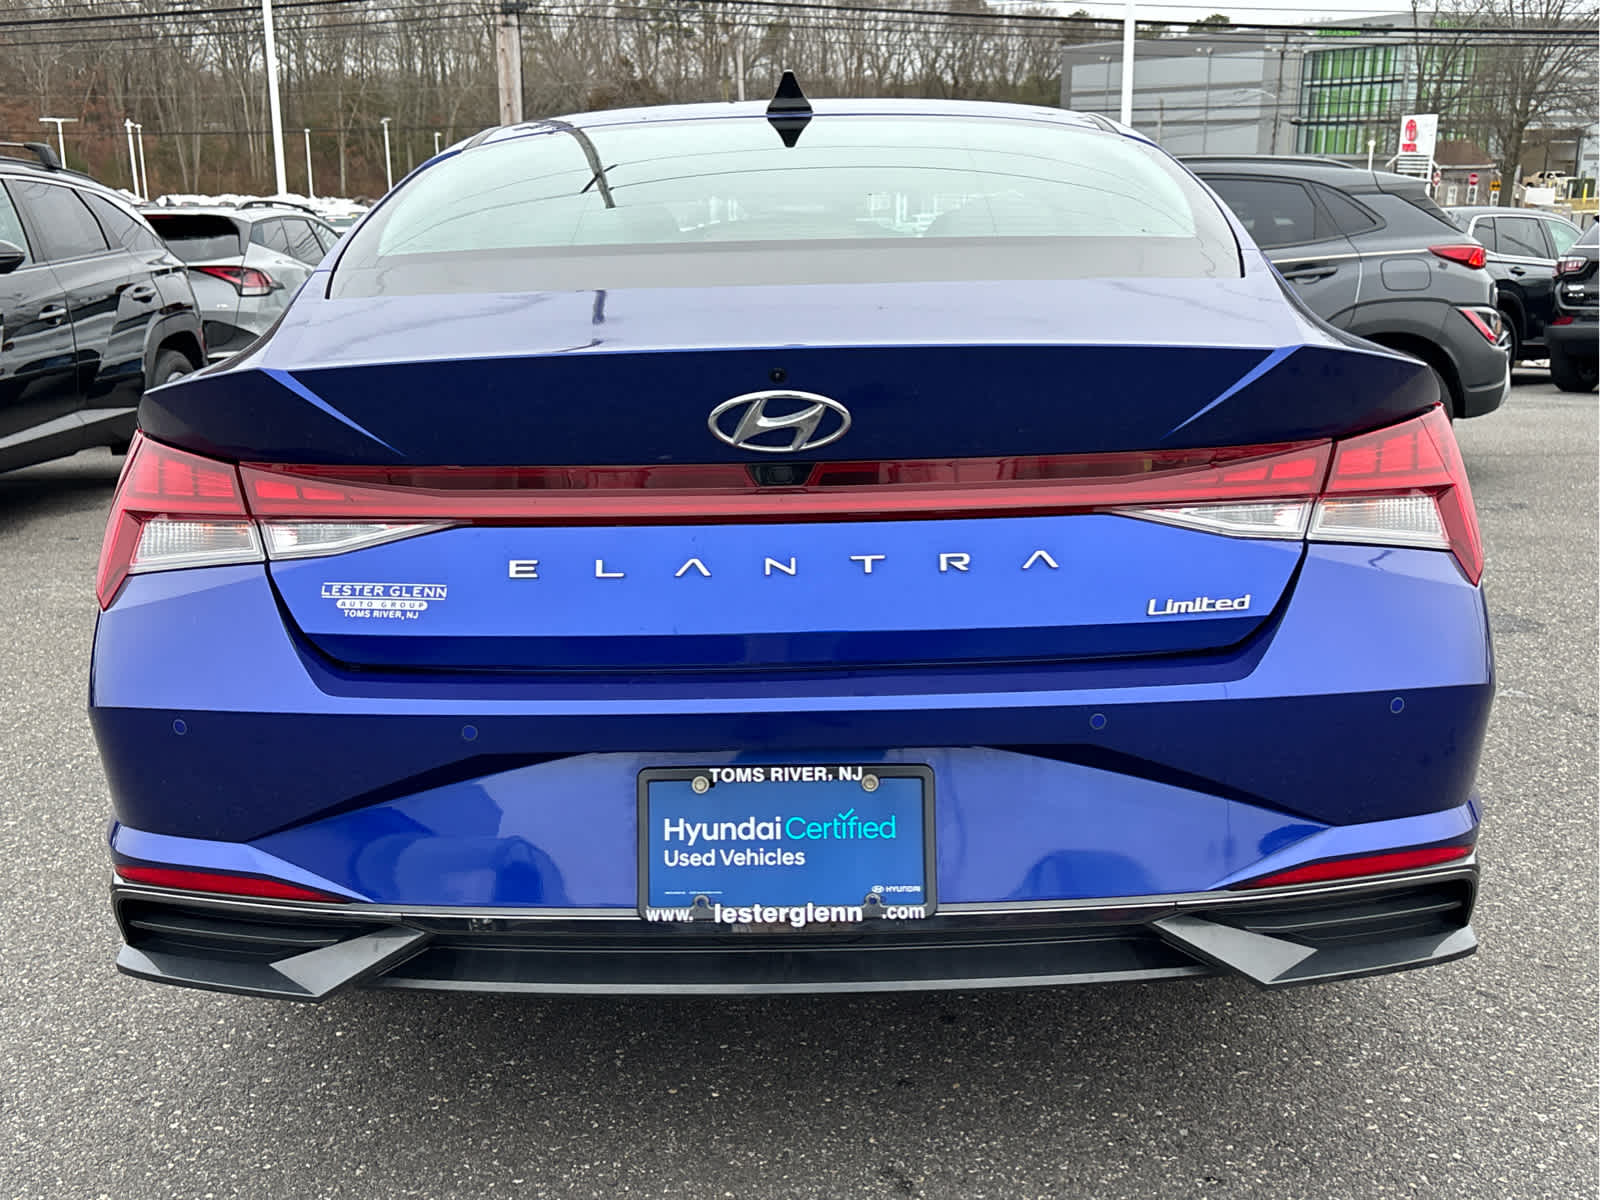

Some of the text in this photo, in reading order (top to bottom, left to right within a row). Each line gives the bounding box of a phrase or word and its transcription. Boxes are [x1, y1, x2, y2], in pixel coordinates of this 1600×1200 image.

[508, 549, 1060, 579] ELANTRA
[321, 585, 448, 598] LESTER GLENN
[344, 609, 419, 620] TOMS RIVER, NJ
[1147, 594, 1251, 616] Limited
[709, 767, 863, 783] TOMS RIVER, NJ
[664, 809, 896, 846] Hyundai Certified
[664, 848, 805, 867] Used Vehicles
[646, 903, 925, 928] www. lesterglenn .com
